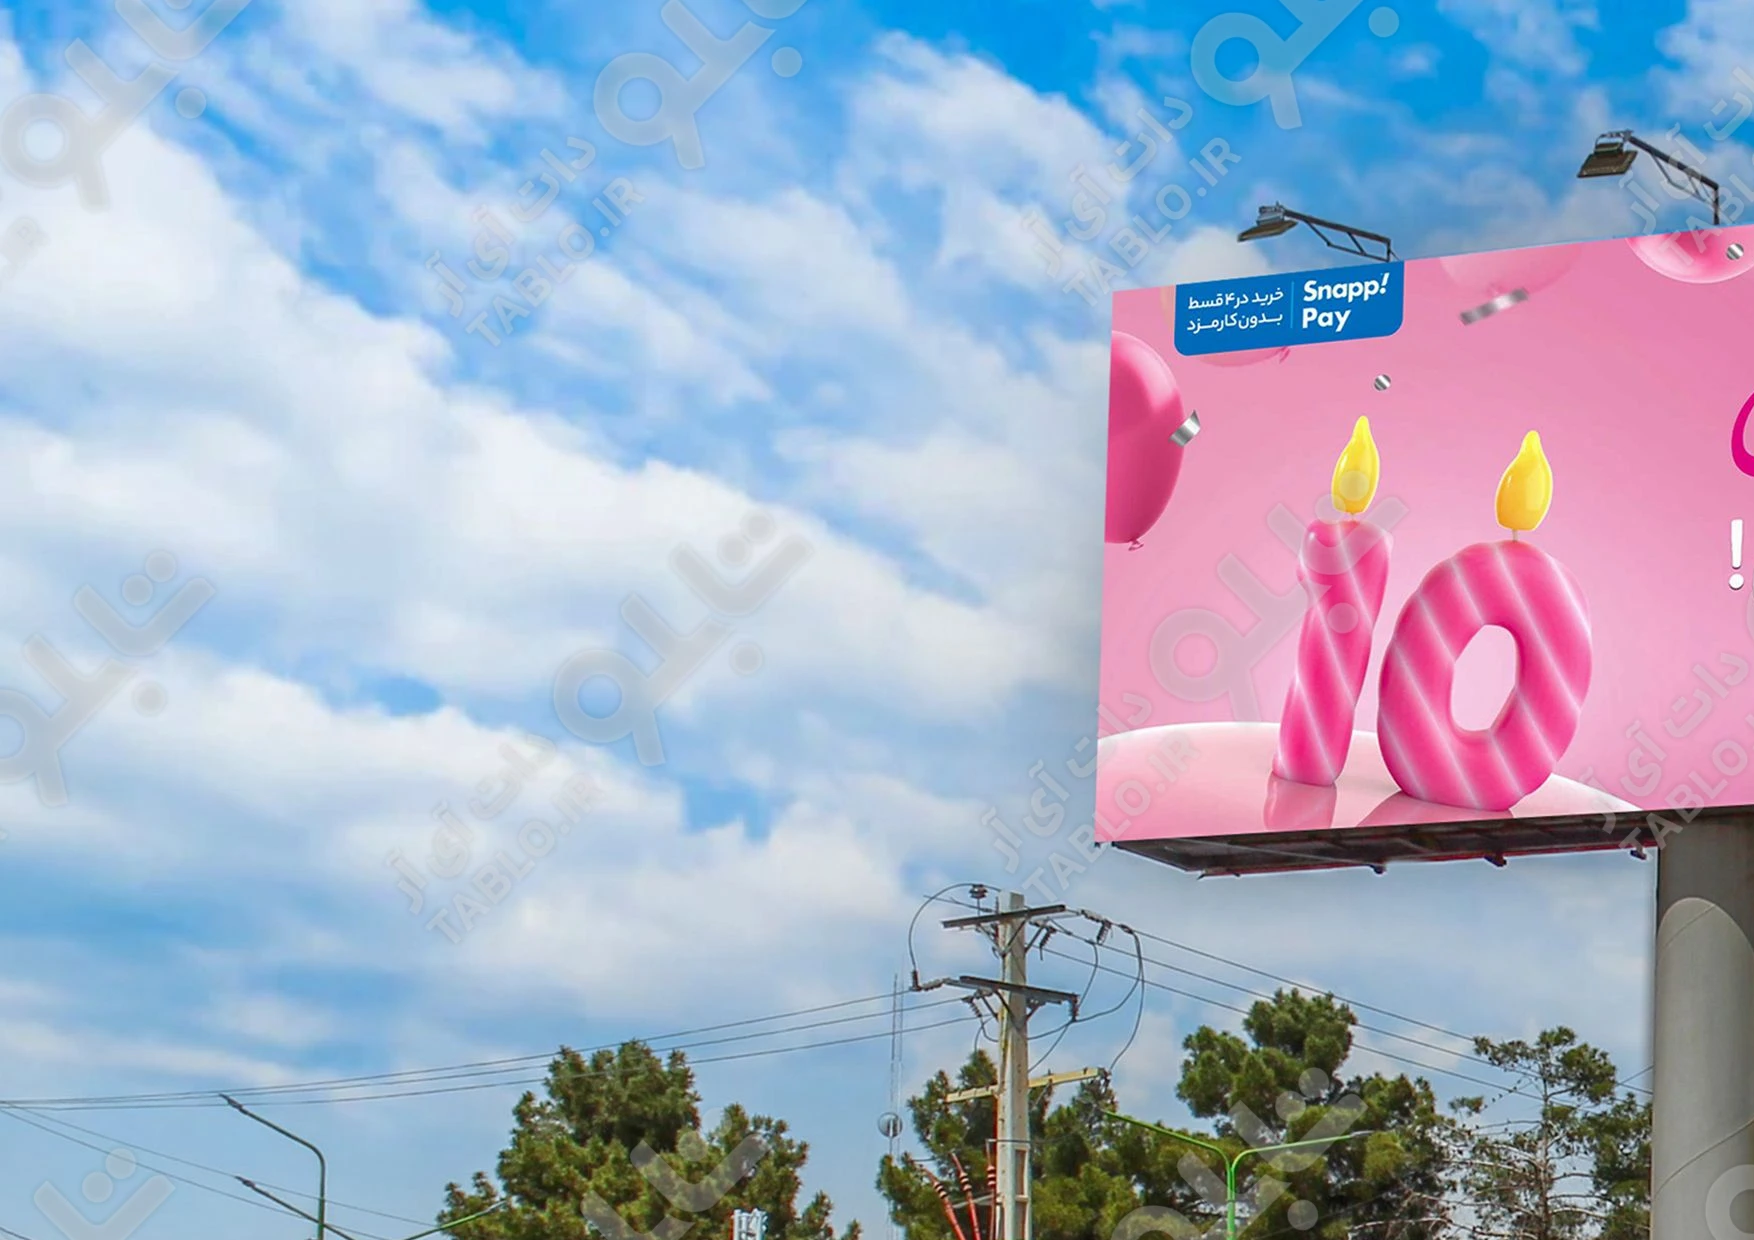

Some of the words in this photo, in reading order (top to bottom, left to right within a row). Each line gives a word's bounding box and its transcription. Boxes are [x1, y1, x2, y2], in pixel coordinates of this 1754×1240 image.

[1303, 272, 1390, 302] Snapp!
[1188, 293, 1223, 310] قسط
[1251, 288, 1284, 306] خرید
[1187, 313, 1238, 334] کارمزد
[1238, 312, 1283, 328] بدون
[1302, 308, 1351, 332] Pay
